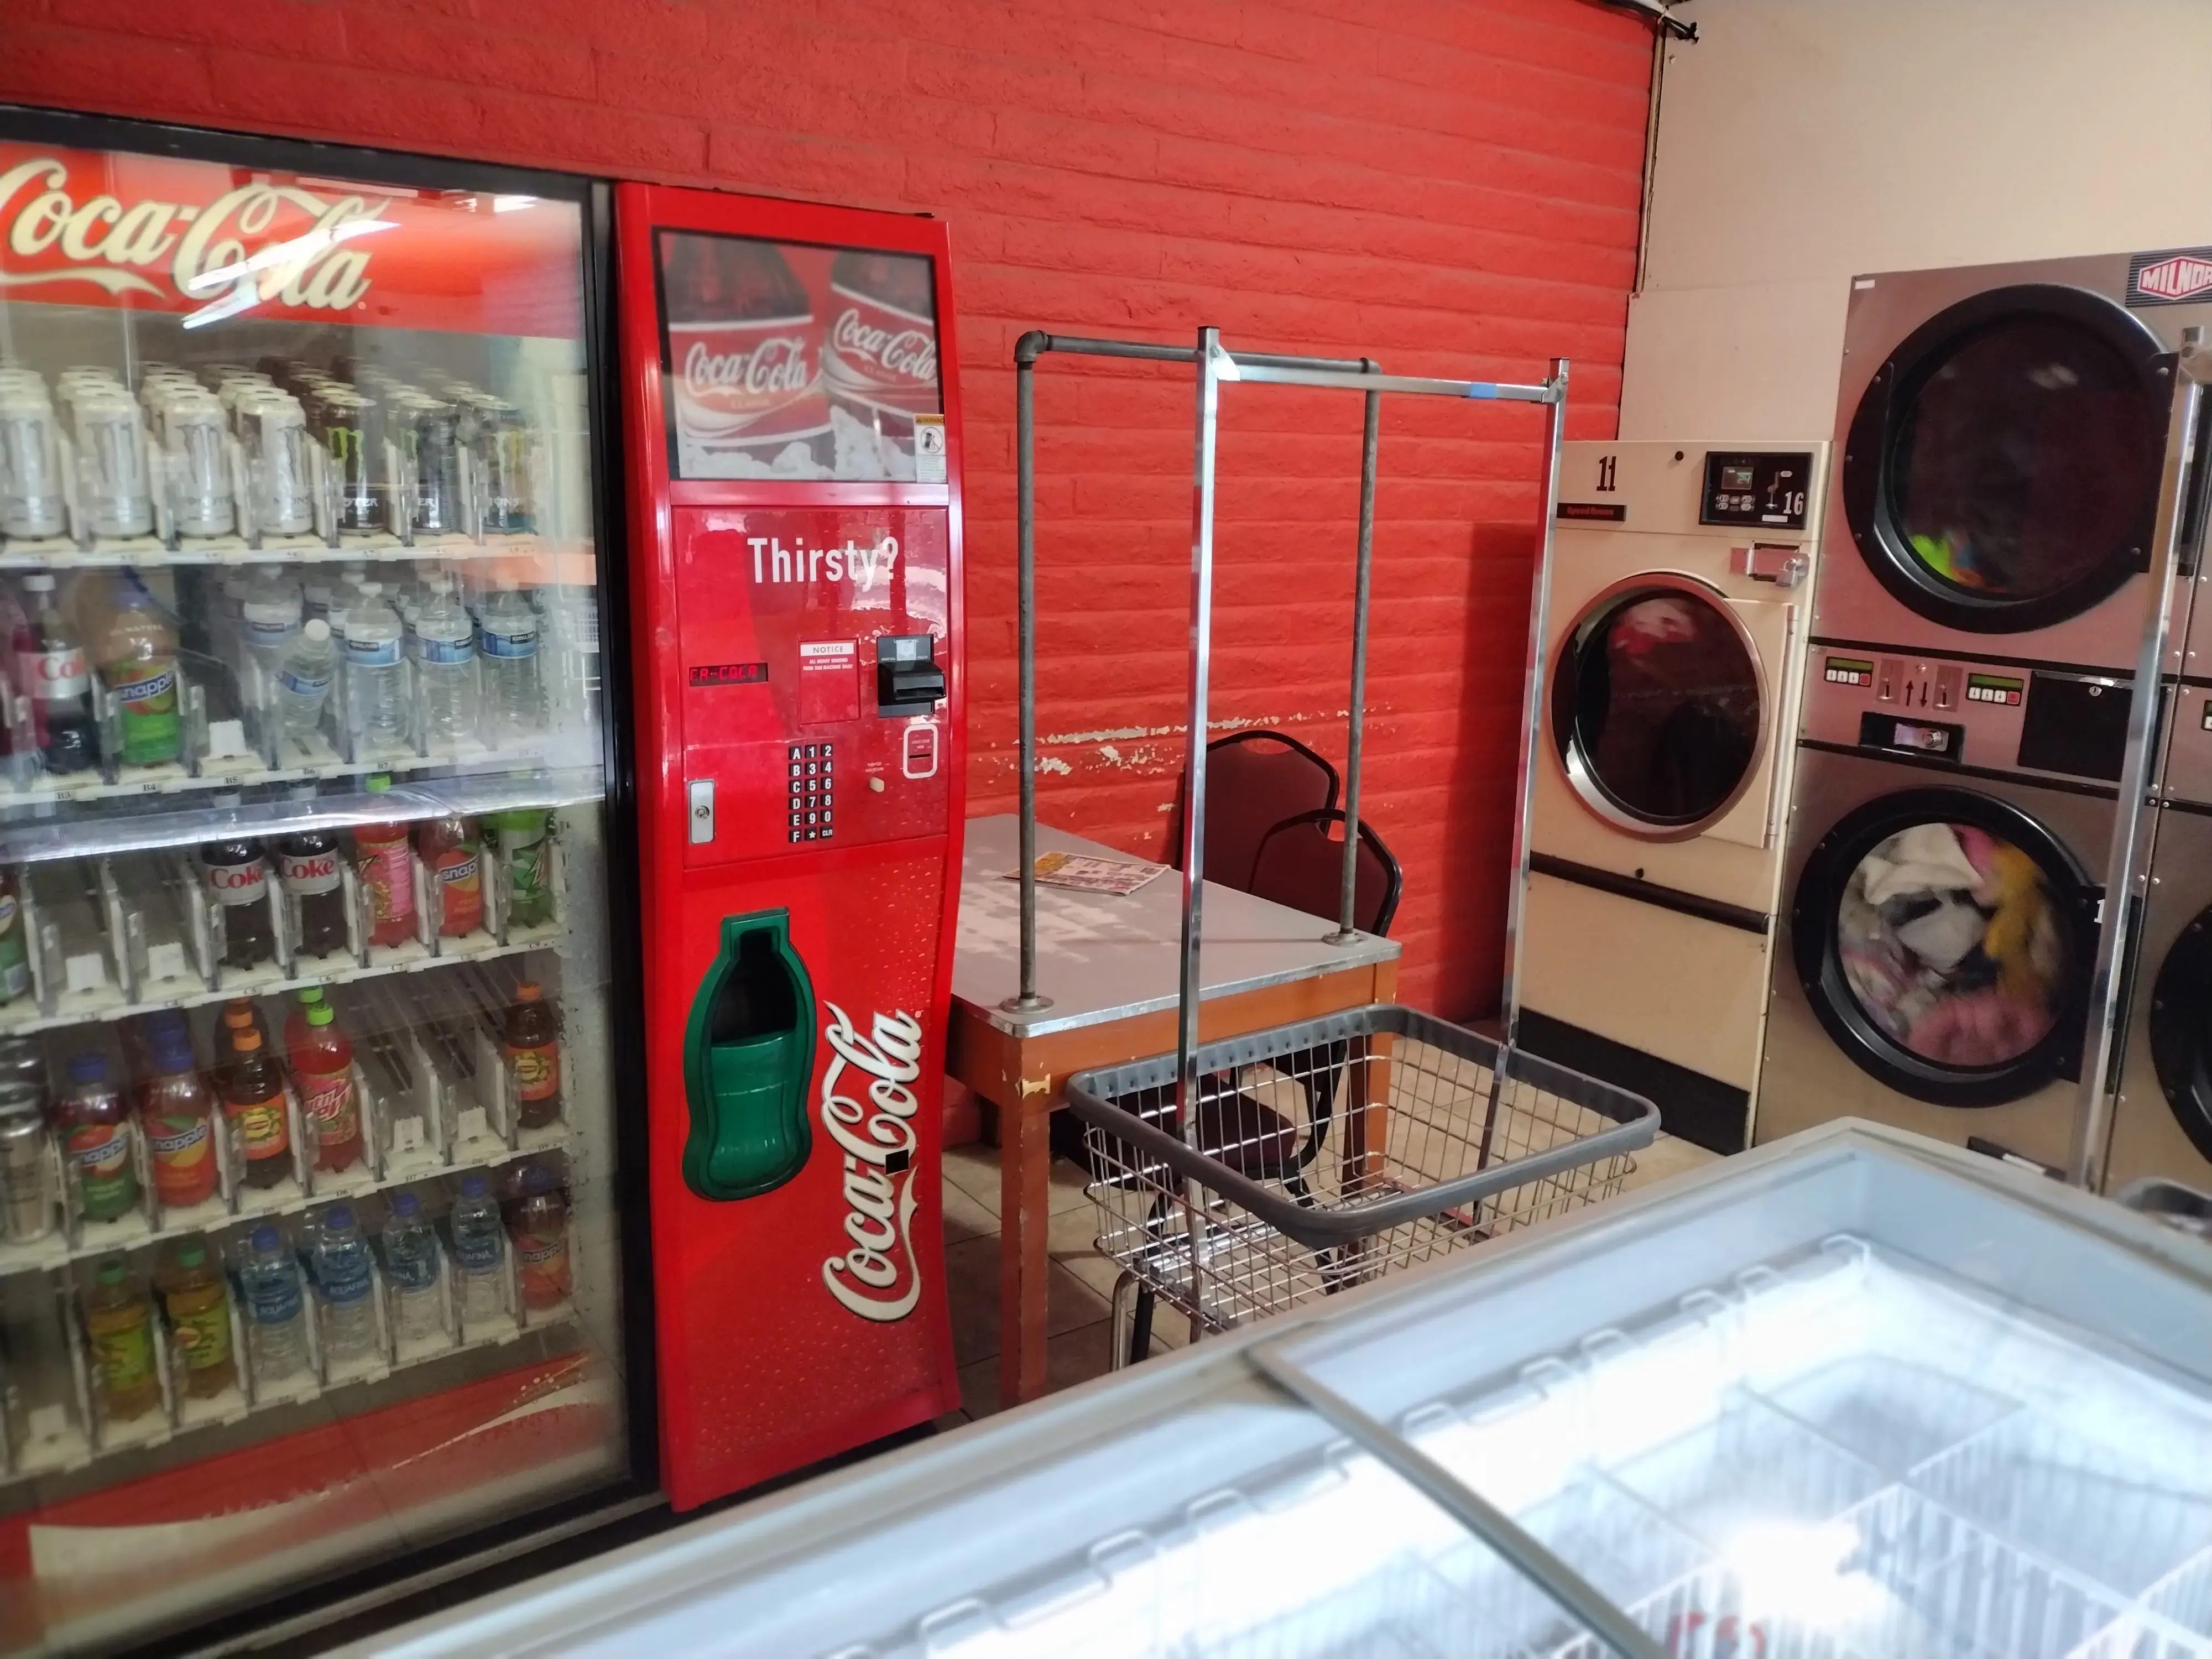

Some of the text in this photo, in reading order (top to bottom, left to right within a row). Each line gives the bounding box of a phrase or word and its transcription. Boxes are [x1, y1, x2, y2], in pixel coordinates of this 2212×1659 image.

[835, 308, 936, 380] Coca-Cola
[685, 336, 809, 397] Coca-Cola
[1783, 491, 1804, 515] 16
[747, 536, 899, 592] Thirsty?
[117, 669, 174, 698] napple
[793, 745, 832, 760] A 1 2
[793, 761, 832, 776] B 3 4
[57, 790, 71, 800] B3
[143, 783, 157, 791] B4
[793, 779, 832, 793] C 5 6
[793, 795, 831, 810] D 7 8
[793, 811, 831, 826] E 9 0
[793, 831, 800, 843] F
[280, 857, 335, 881] Coke
[443, 860, 480, 881] snap
[154, 1124, 208, 1152] napple
[822, 999, 922, 1322] Coca-Cola
